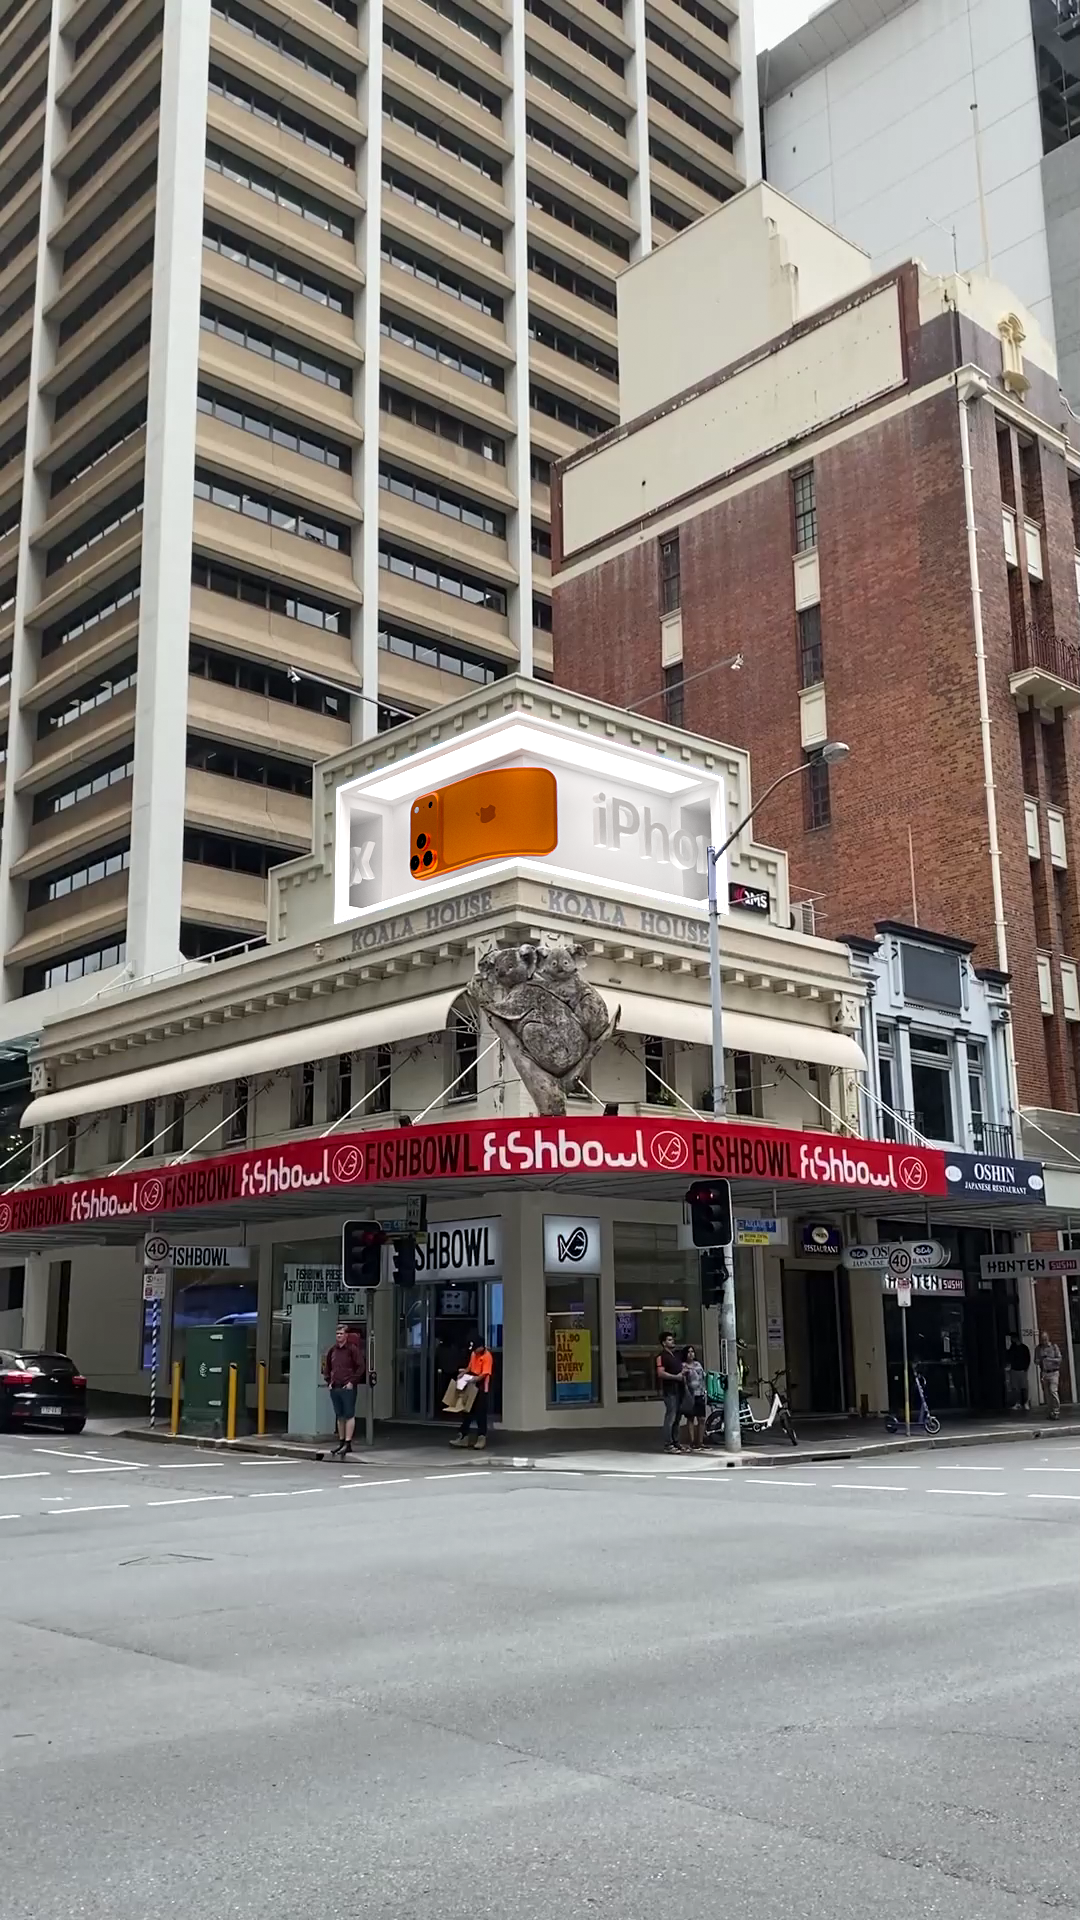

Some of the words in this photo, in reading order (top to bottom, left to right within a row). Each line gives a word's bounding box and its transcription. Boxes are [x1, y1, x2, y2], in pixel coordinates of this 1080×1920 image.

[351, 919, 414, 952] KOALA
[426, 889, 493, 930] HOUSE
[548, 888, 627, 927] KOALA
[640, 910, 709, 944] HOUSE
[11, 1192, 70, 1230] FISHBOWL
[70, 1182, 138, 1221] fishbowl
[163, 1166, 240, 1208] FISHBOWL
[241, 1148, 330, 1196] fishbowl
[365, 1133, 479, 1181] FISHBOWL
[483, 1129, 648, 1171] fishbowl
[692, 1133, 798, 1179] FISHBOWL
[800, 1144, 898, 1188] fishbowl
[974, 1163, 1016, 1183] OSHIN
[965, 1181, 992, 1192] JAPANESE
[992, 1184, 1027, 1195] RESTAURANT
[148, 1243, 166, 1255] 40
[415, 1227, 495, 1271] SHBOWL
[803, 1244, 838, 1253] RESTAURANT
[892, 1254, 907, 1268] 40
[987, 1258, 1045, 1274] HONTEN
[1051, 1261, 1076, 1269] SUSHI
[942, 1280, 963, 1290] SUSHI
[557, 1333, 580, 1343] 11.90
[557, 1343, 573, 1352] ALL
[557, 1353, 573, 1362] DAY
[557, 1363, 584, 1372] EVERY
[557, 1373, 574, 1381] DAY
